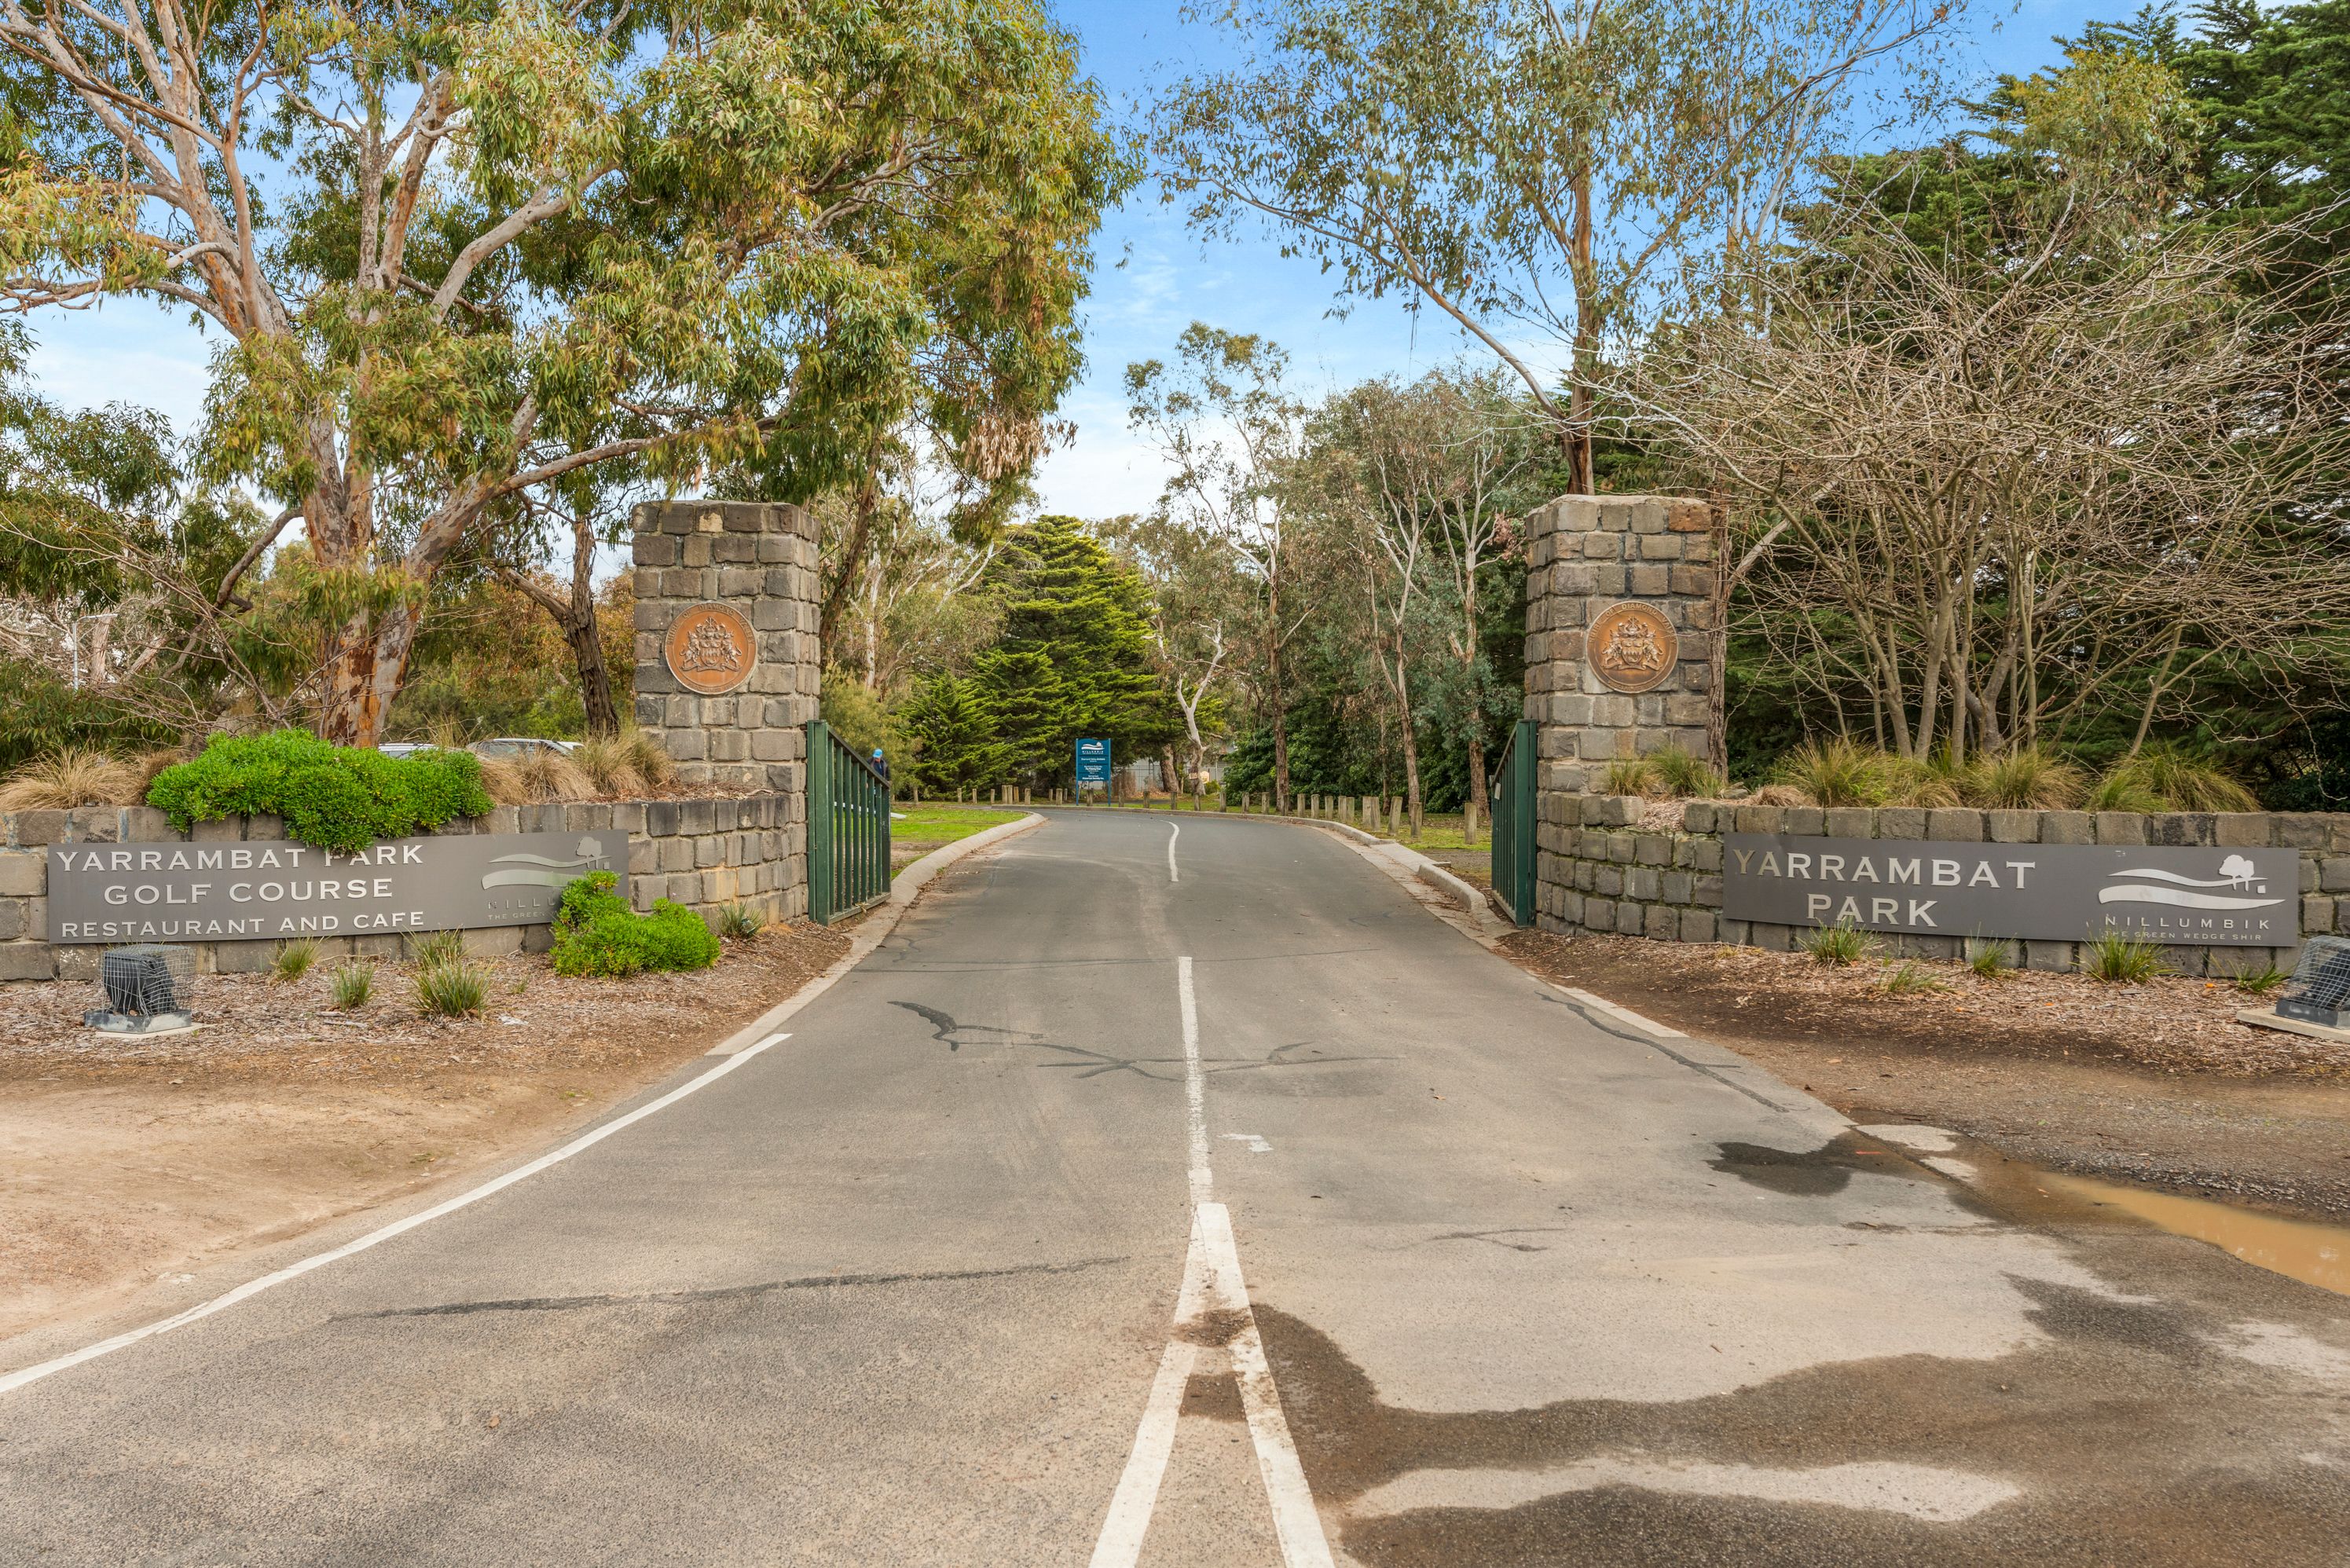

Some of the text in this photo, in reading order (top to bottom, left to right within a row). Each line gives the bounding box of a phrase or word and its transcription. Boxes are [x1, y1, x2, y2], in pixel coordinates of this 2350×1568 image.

[1622, 603, 1657, 616] DIAMOND
[56, 848, 306, 871] YARRAMBAT
[104, 877, 392, 905] GOLF COURSE
[1732, 848, 2036, 928] YARRAMBAT PARK
[487, 897, 555, 910] NILLU
[61, 911, 423, 937] RESTAURANT AND CAFE
[2105, 916, 2270, 930] NILLUMBIK
